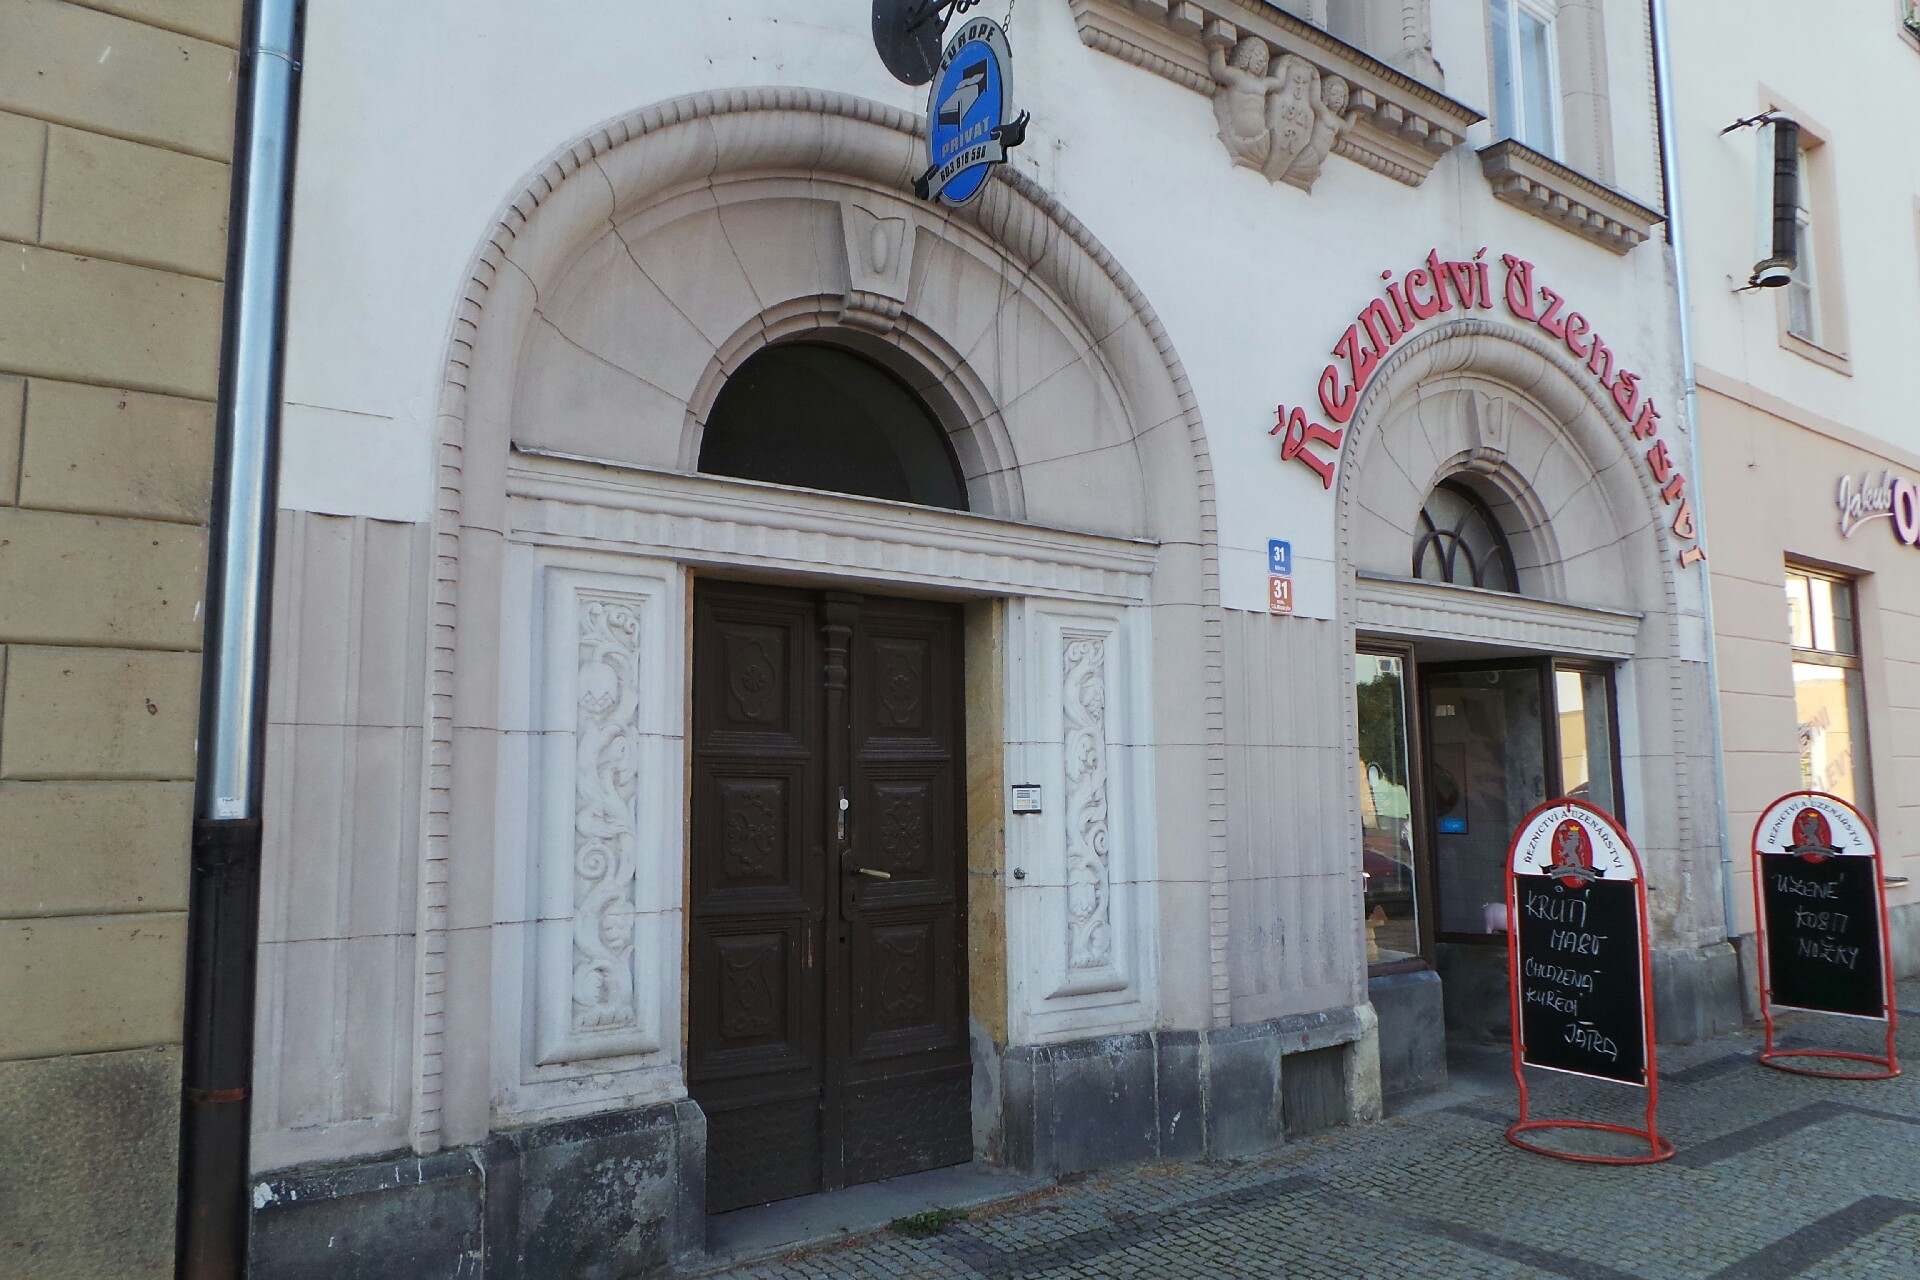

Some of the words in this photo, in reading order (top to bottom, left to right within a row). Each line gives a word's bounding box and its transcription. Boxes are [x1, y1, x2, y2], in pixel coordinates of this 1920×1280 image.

[941, 24, 995, 72] EUROPE
[941, 116, 990, 159] PRIVAT
[940, 162, 955, 183] 603
[1269, 247, 1493, 490] Řeznictví
[1273, 546, 1285, 562] 31
[1273, 579, 1288, 600] 31
[1525, 885, 1591, 928] KRŮTÍ
[1550, 928, 1608, 955] MASO
[1797, 936, 1859, 970] NOŽKY
